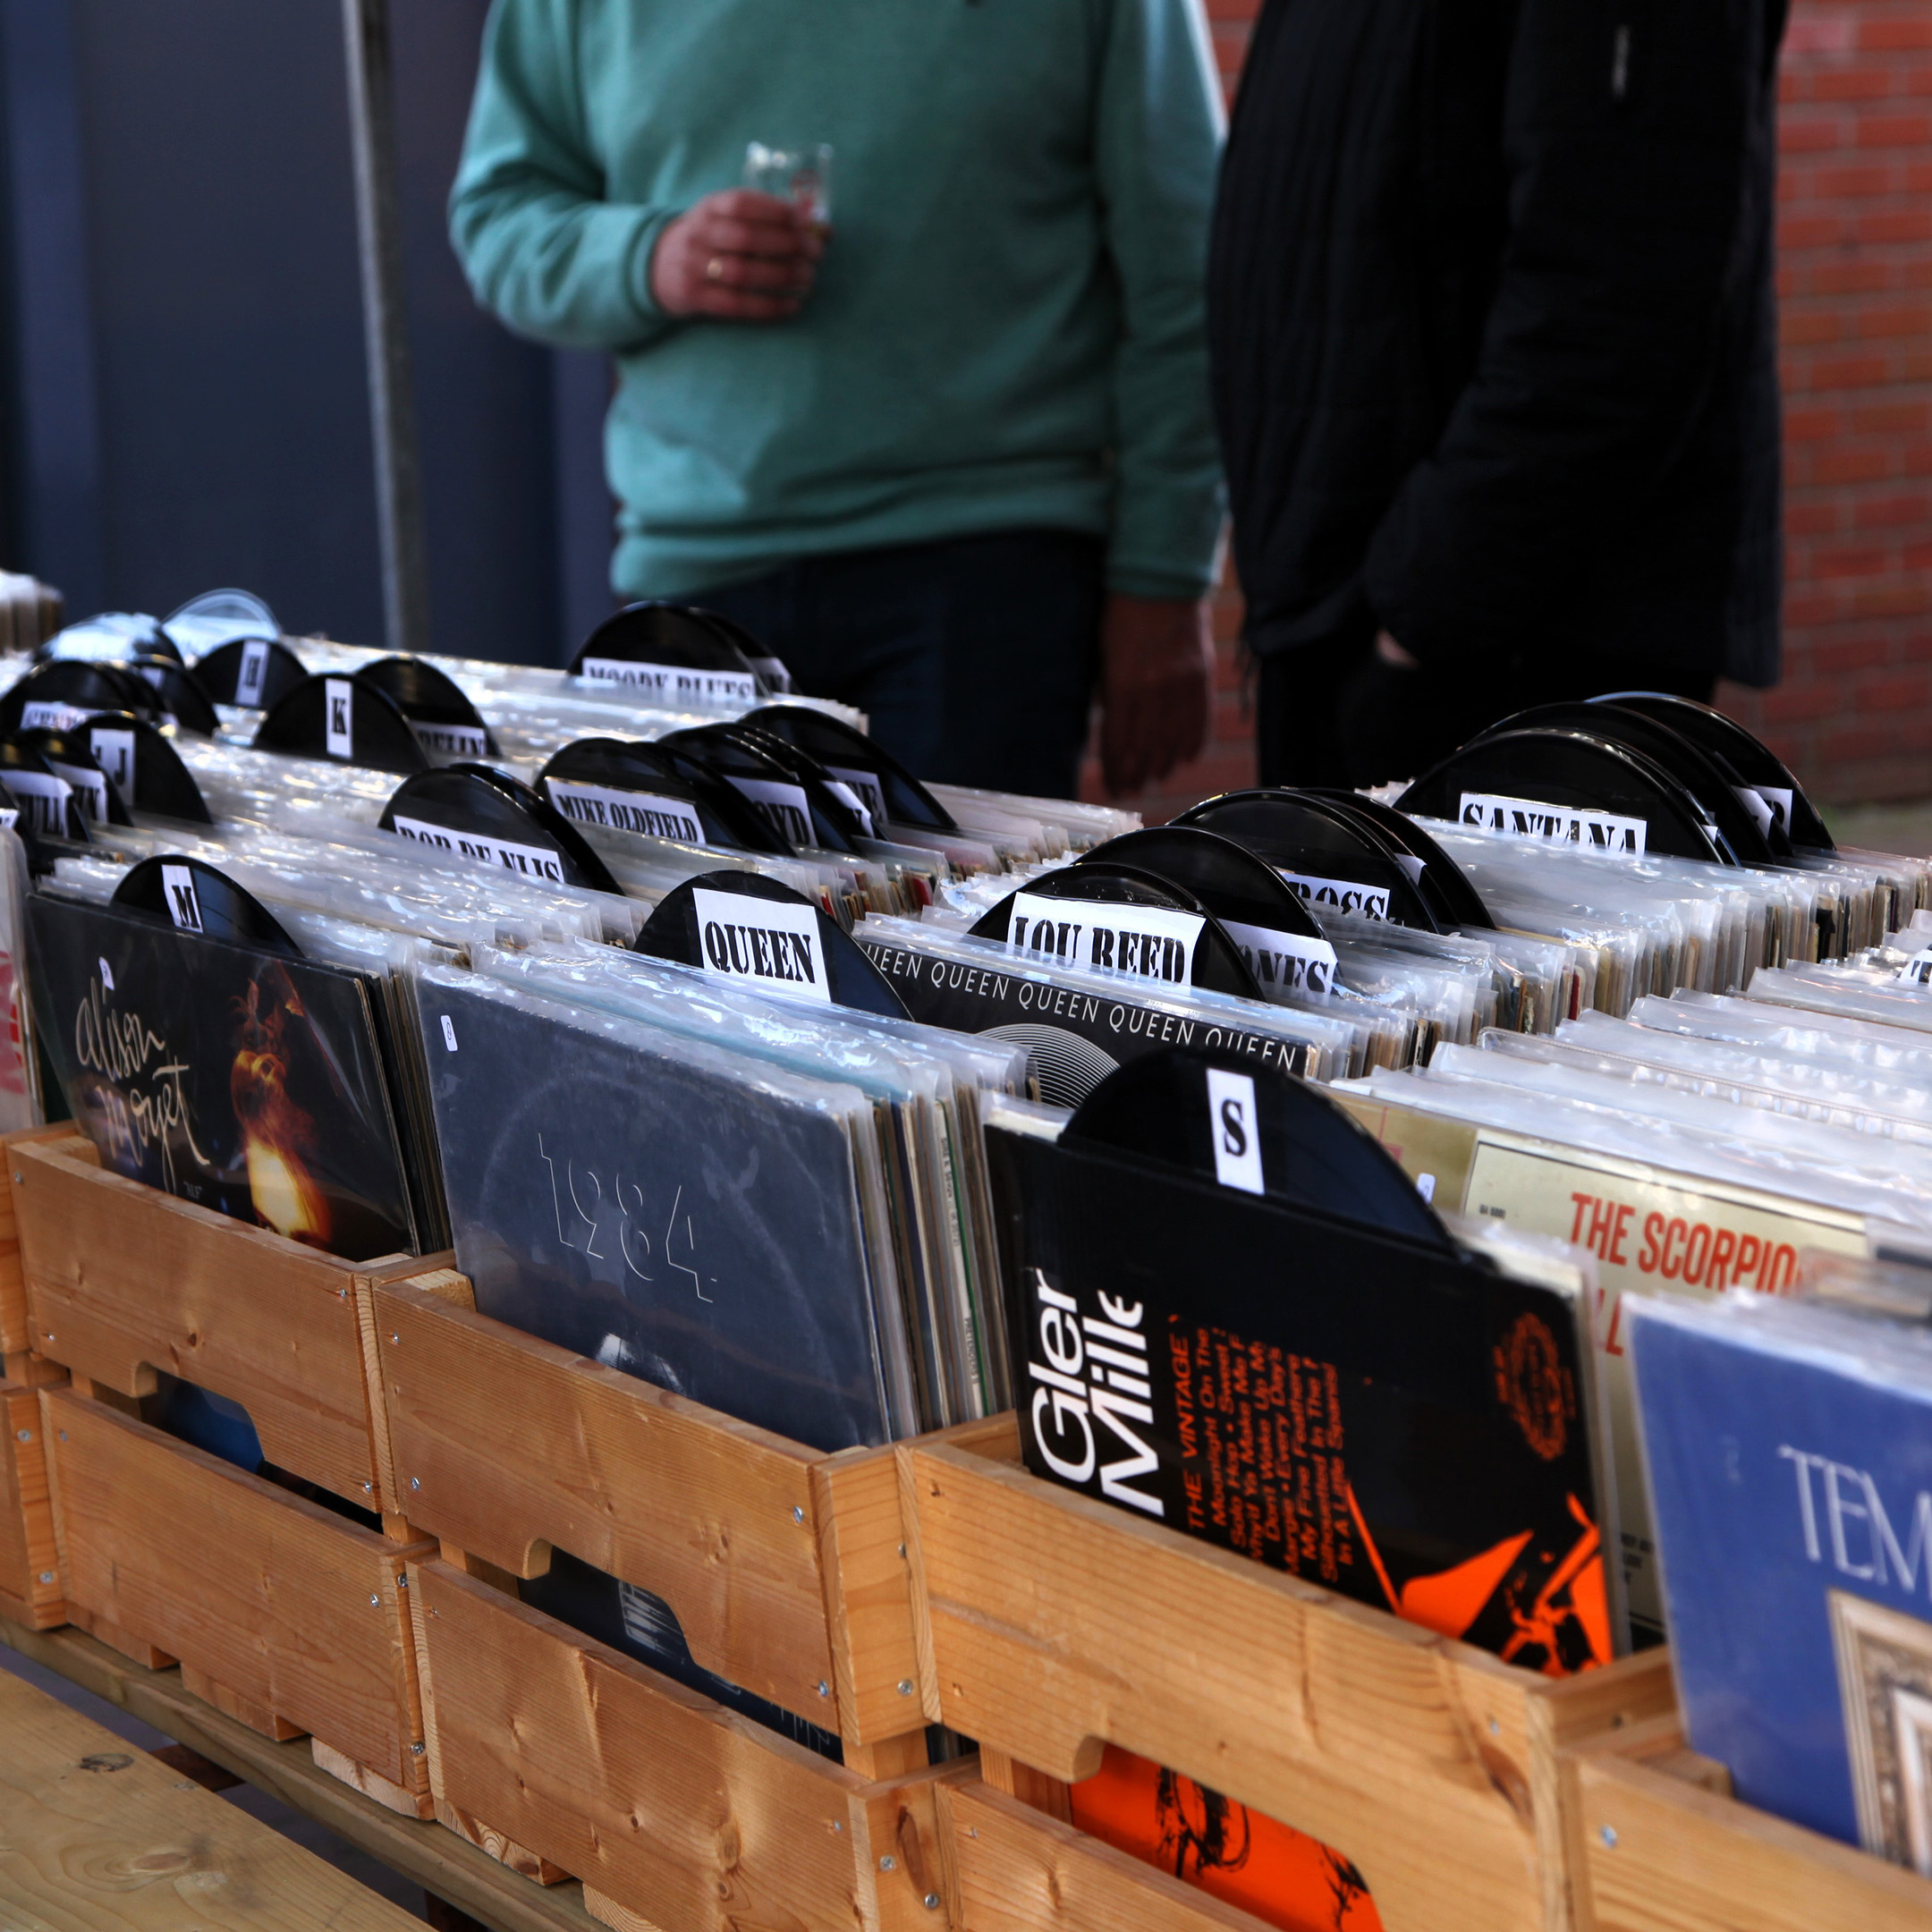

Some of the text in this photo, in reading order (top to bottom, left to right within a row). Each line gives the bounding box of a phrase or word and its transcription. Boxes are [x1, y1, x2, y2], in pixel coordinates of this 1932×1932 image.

[331, 698, 347, 735] K
[555, 794, 699, 843] MIKE OLDFIELD
[1463, 803, 1637, 852] SANTANA
[172, 885, 200, 928] M
[705, 920, 816, 984] QUEEN
[1090, 927, 1185, 983] REED
[930, 961, 1010, 1001] QUEEN
[1018, 982, 1100, 1023] QUEEN
[1108, 1004, 1195, 1046] QUEEN
[1205, 1027, 1297, 1072] QUEEN
[1221, 1097, 1248, 1158] S
[538, 1132, 717, 1303] 1984
[1570, 1191, 1636, 1266] THE
[1216, 1344, 1234, 1414] Sweet
[1233, 1357, 1248, 1394] Me
[1250, 1378, 1269, 1411] Up
[1305, 1377, 1322, 1419] The
[1169, 1333, 1205, 1529] THE VINTAGE
[1197, 1328, 1227, 1526] Moonlight On The
[1237, 1402, 1256, 1464] Make
[1256, 1419, 1273, 1479] Wake
[1274, 1412, 1293, 1479] Every
[1224, 1443, 1241, 1488] Hop
[1294, 1465, 1314, 1517] Fine
[1228, 1496, 1247, 1547] Solo
[1300, 1523, 1318, 1560] My
[1335, 1520, 1351, 1538] A
[1776, 1445, 1932, 1604] TEM
[1339, 1541, 1354, 1565] In
